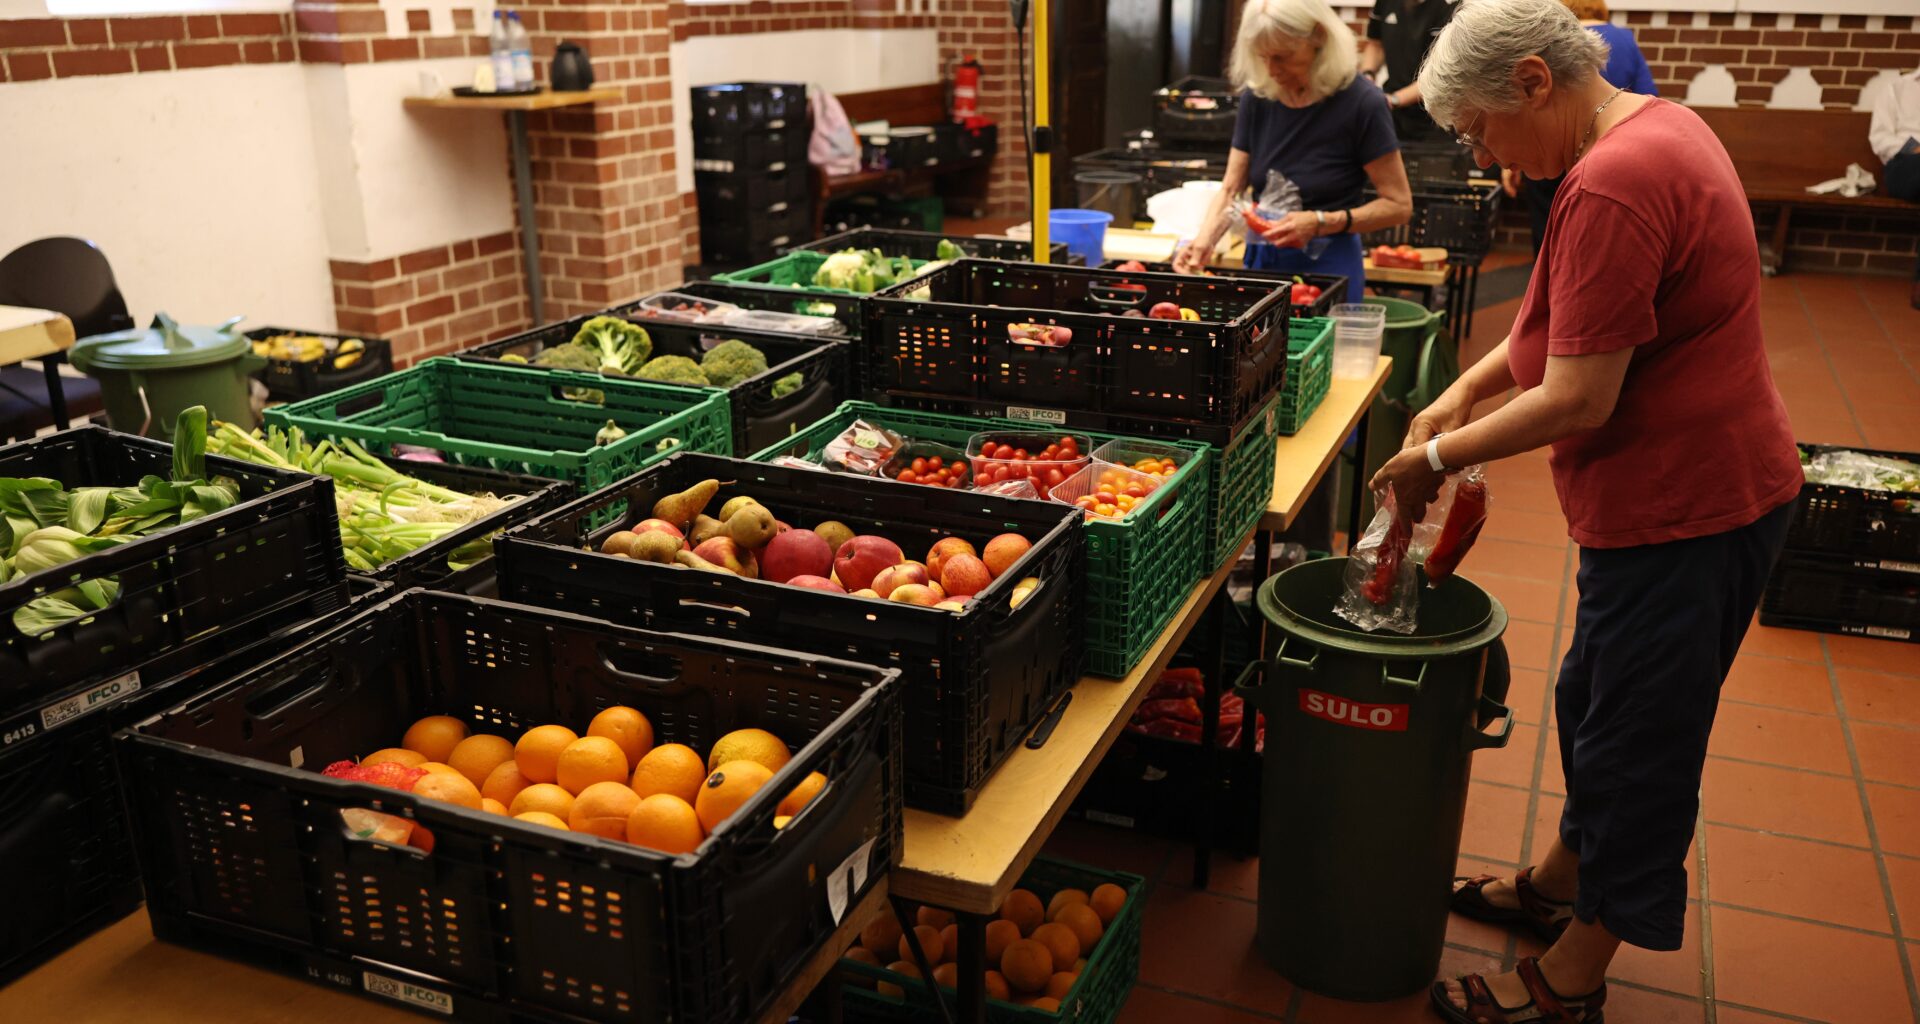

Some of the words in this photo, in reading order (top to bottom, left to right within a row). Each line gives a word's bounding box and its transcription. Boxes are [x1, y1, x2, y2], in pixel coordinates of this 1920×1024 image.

[1032, 409, 1054, 419] IFCO
[87, 683, 121, 704] IFCO
[1307, 693, 1393, 726] SULO
[4, 723, 36, 744] 6413
[403, 985, 435, 1003] IFCO
